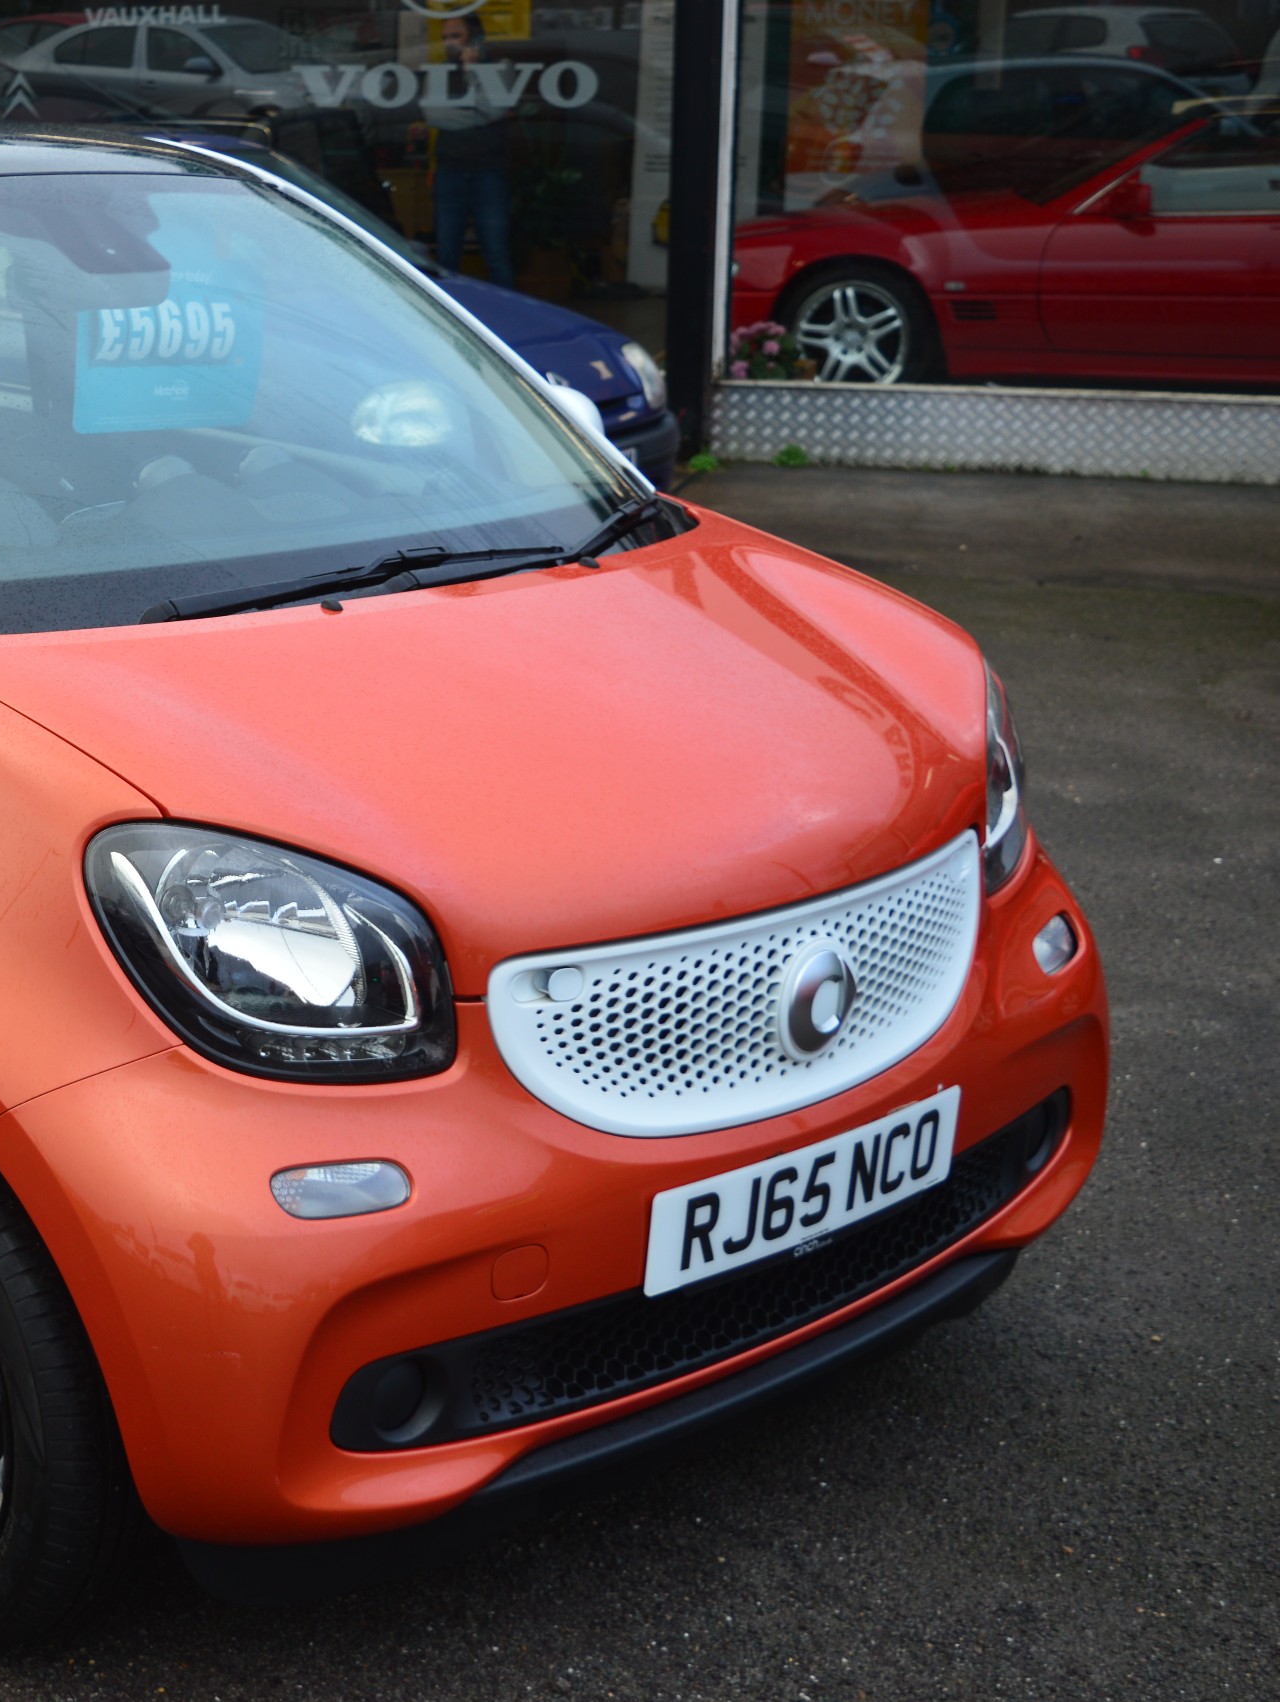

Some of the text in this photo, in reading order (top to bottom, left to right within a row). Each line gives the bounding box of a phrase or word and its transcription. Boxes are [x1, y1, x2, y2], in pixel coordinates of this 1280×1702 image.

[83, 4, 228, 27] VAUXHALL
[804, 0, 917, 25] MONEY
[291, 60, 599, 109] VOLVO
[95, 298, 236, 361] £5695
[679, 1108, 940, 1272] RJ65 NCO
